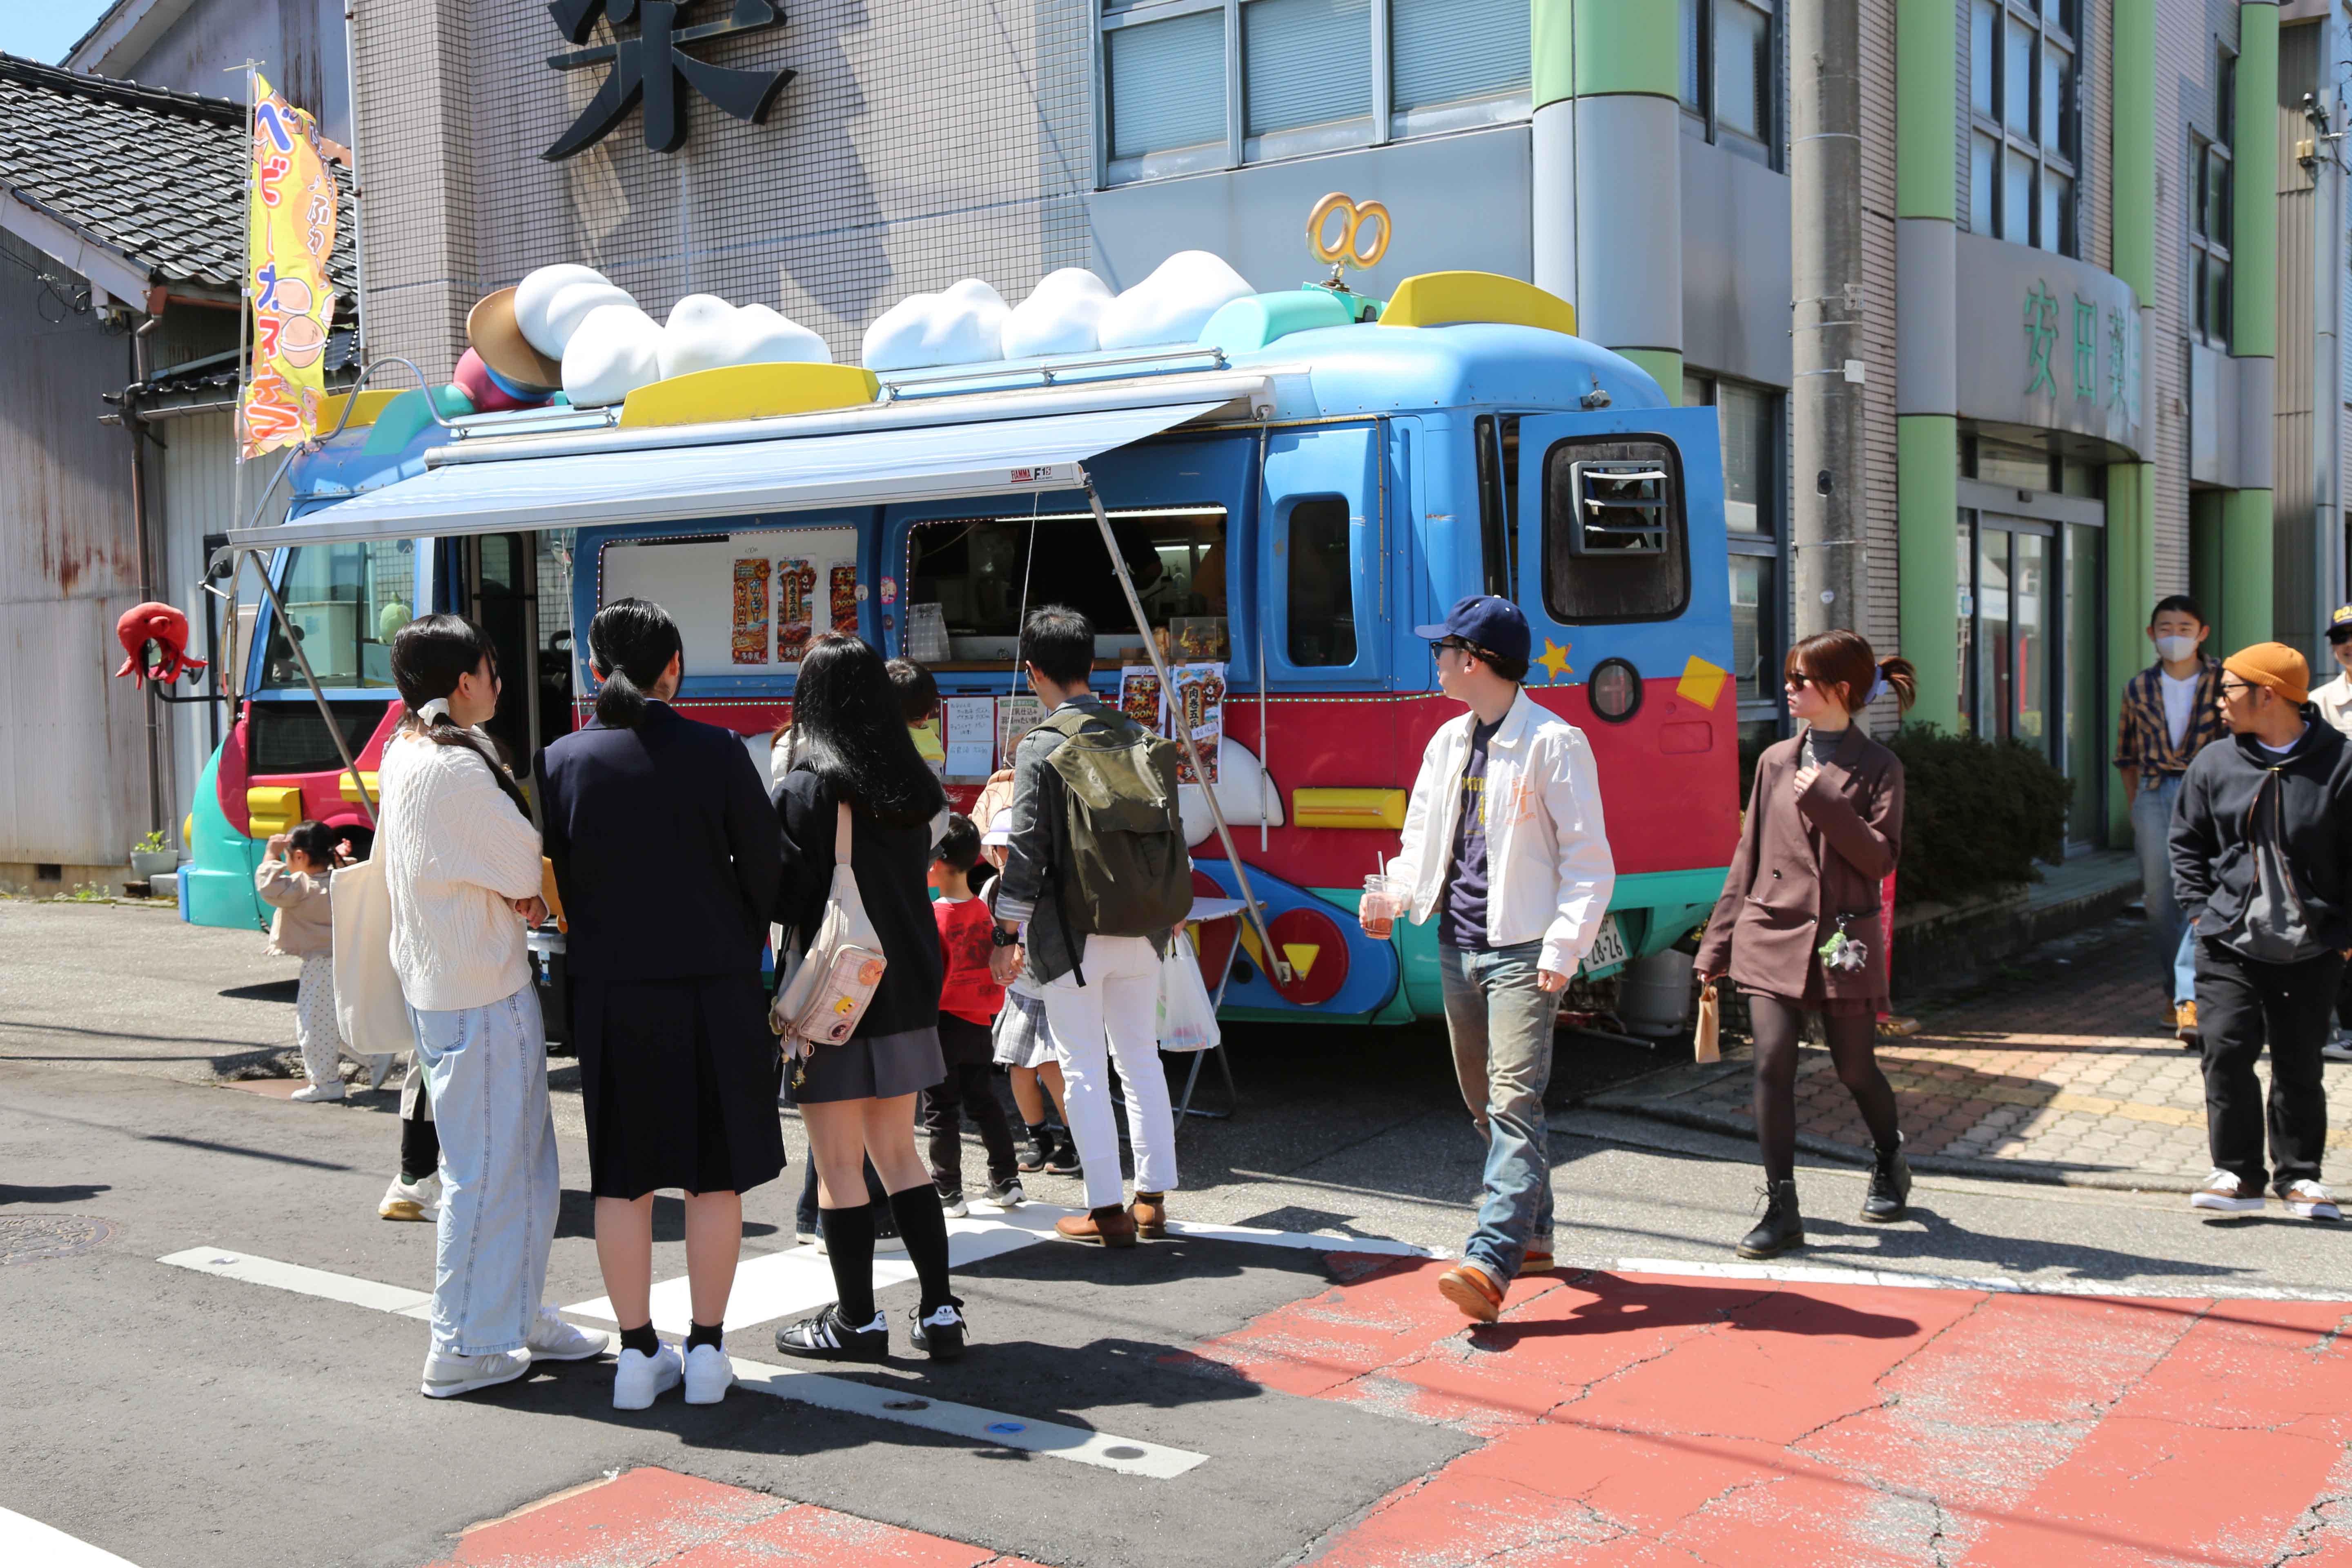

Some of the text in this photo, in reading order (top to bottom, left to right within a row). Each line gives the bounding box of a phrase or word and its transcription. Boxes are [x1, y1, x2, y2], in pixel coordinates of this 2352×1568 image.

[1011, 468, 1031, 480] FIAMMA
[784, 646, 802, 658] 多幸
[1188, 688, 1199, 728] 肉巻五兵
[1184, 766, 1212, 779] 多屋
